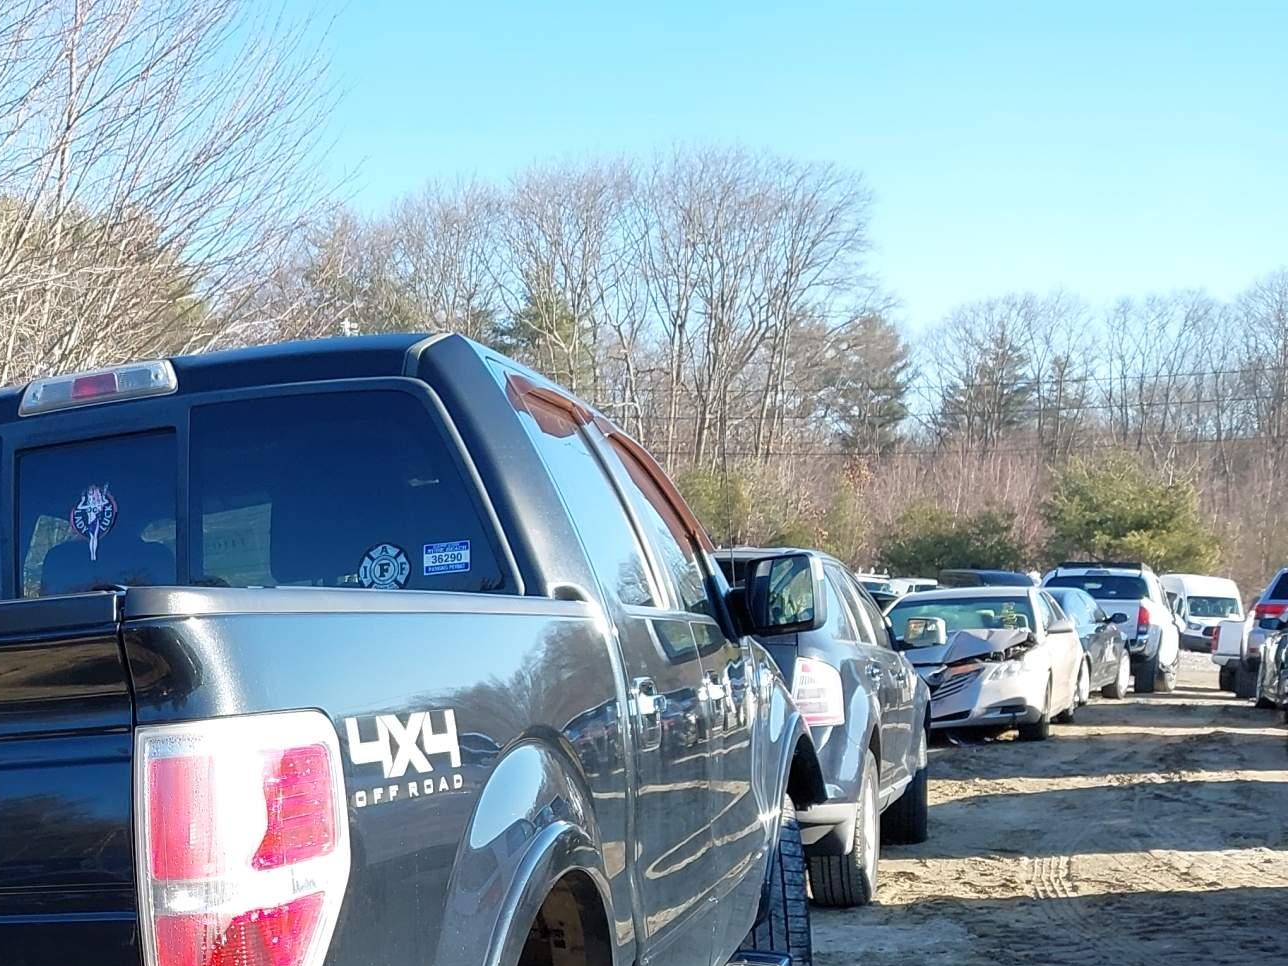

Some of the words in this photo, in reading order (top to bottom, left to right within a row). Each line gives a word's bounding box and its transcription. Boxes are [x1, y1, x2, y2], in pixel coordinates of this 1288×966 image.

[74, 510, 89, 534] LADY
[99, 504, 113, 531] LUCK
[431, 552, 463, 565] 36290
[344, 708, 462, 779] 4X4
[355, 784, 399, 808] OFF
[408, 773, 463, 798] ROAD
